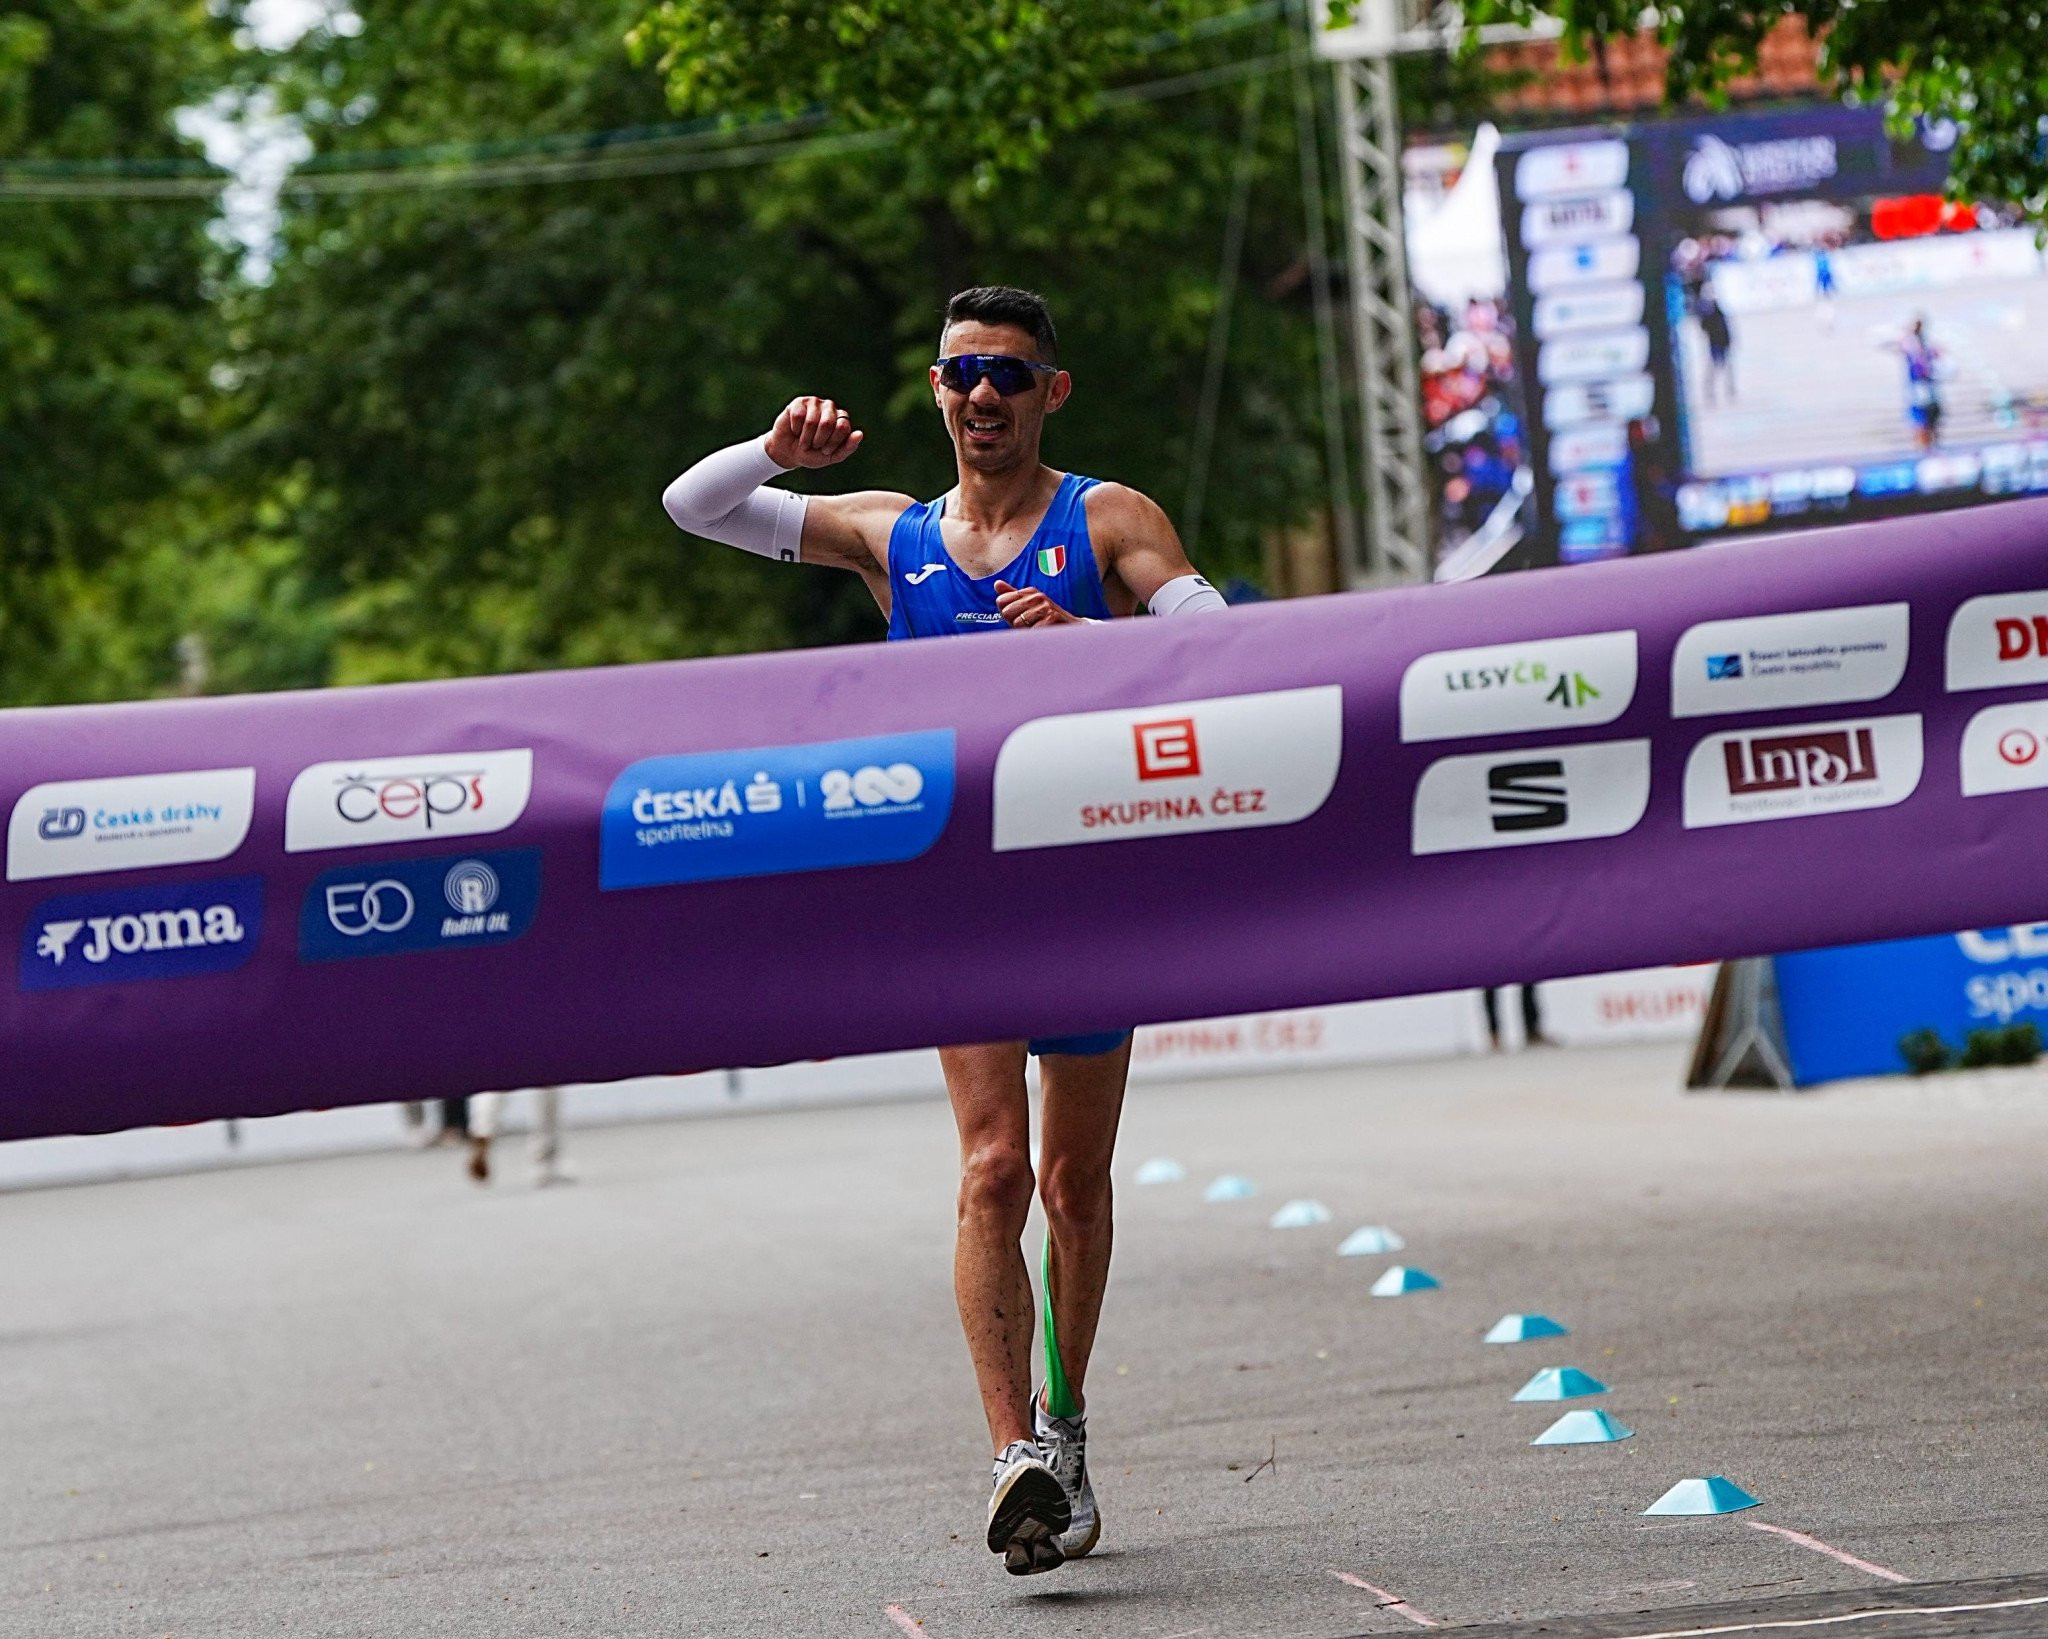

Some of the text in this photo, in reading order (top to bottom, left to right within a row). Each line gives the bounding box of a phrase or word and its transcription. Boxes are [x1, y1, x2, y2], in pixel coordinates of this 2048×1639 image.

[93, 807, 154, 830] České
[161, 802, 222, 823] dráhy
[631, 779, 743, 824] ČESKÁ
[1080, 786, 1267, 829] SKUPINA ČEZ
